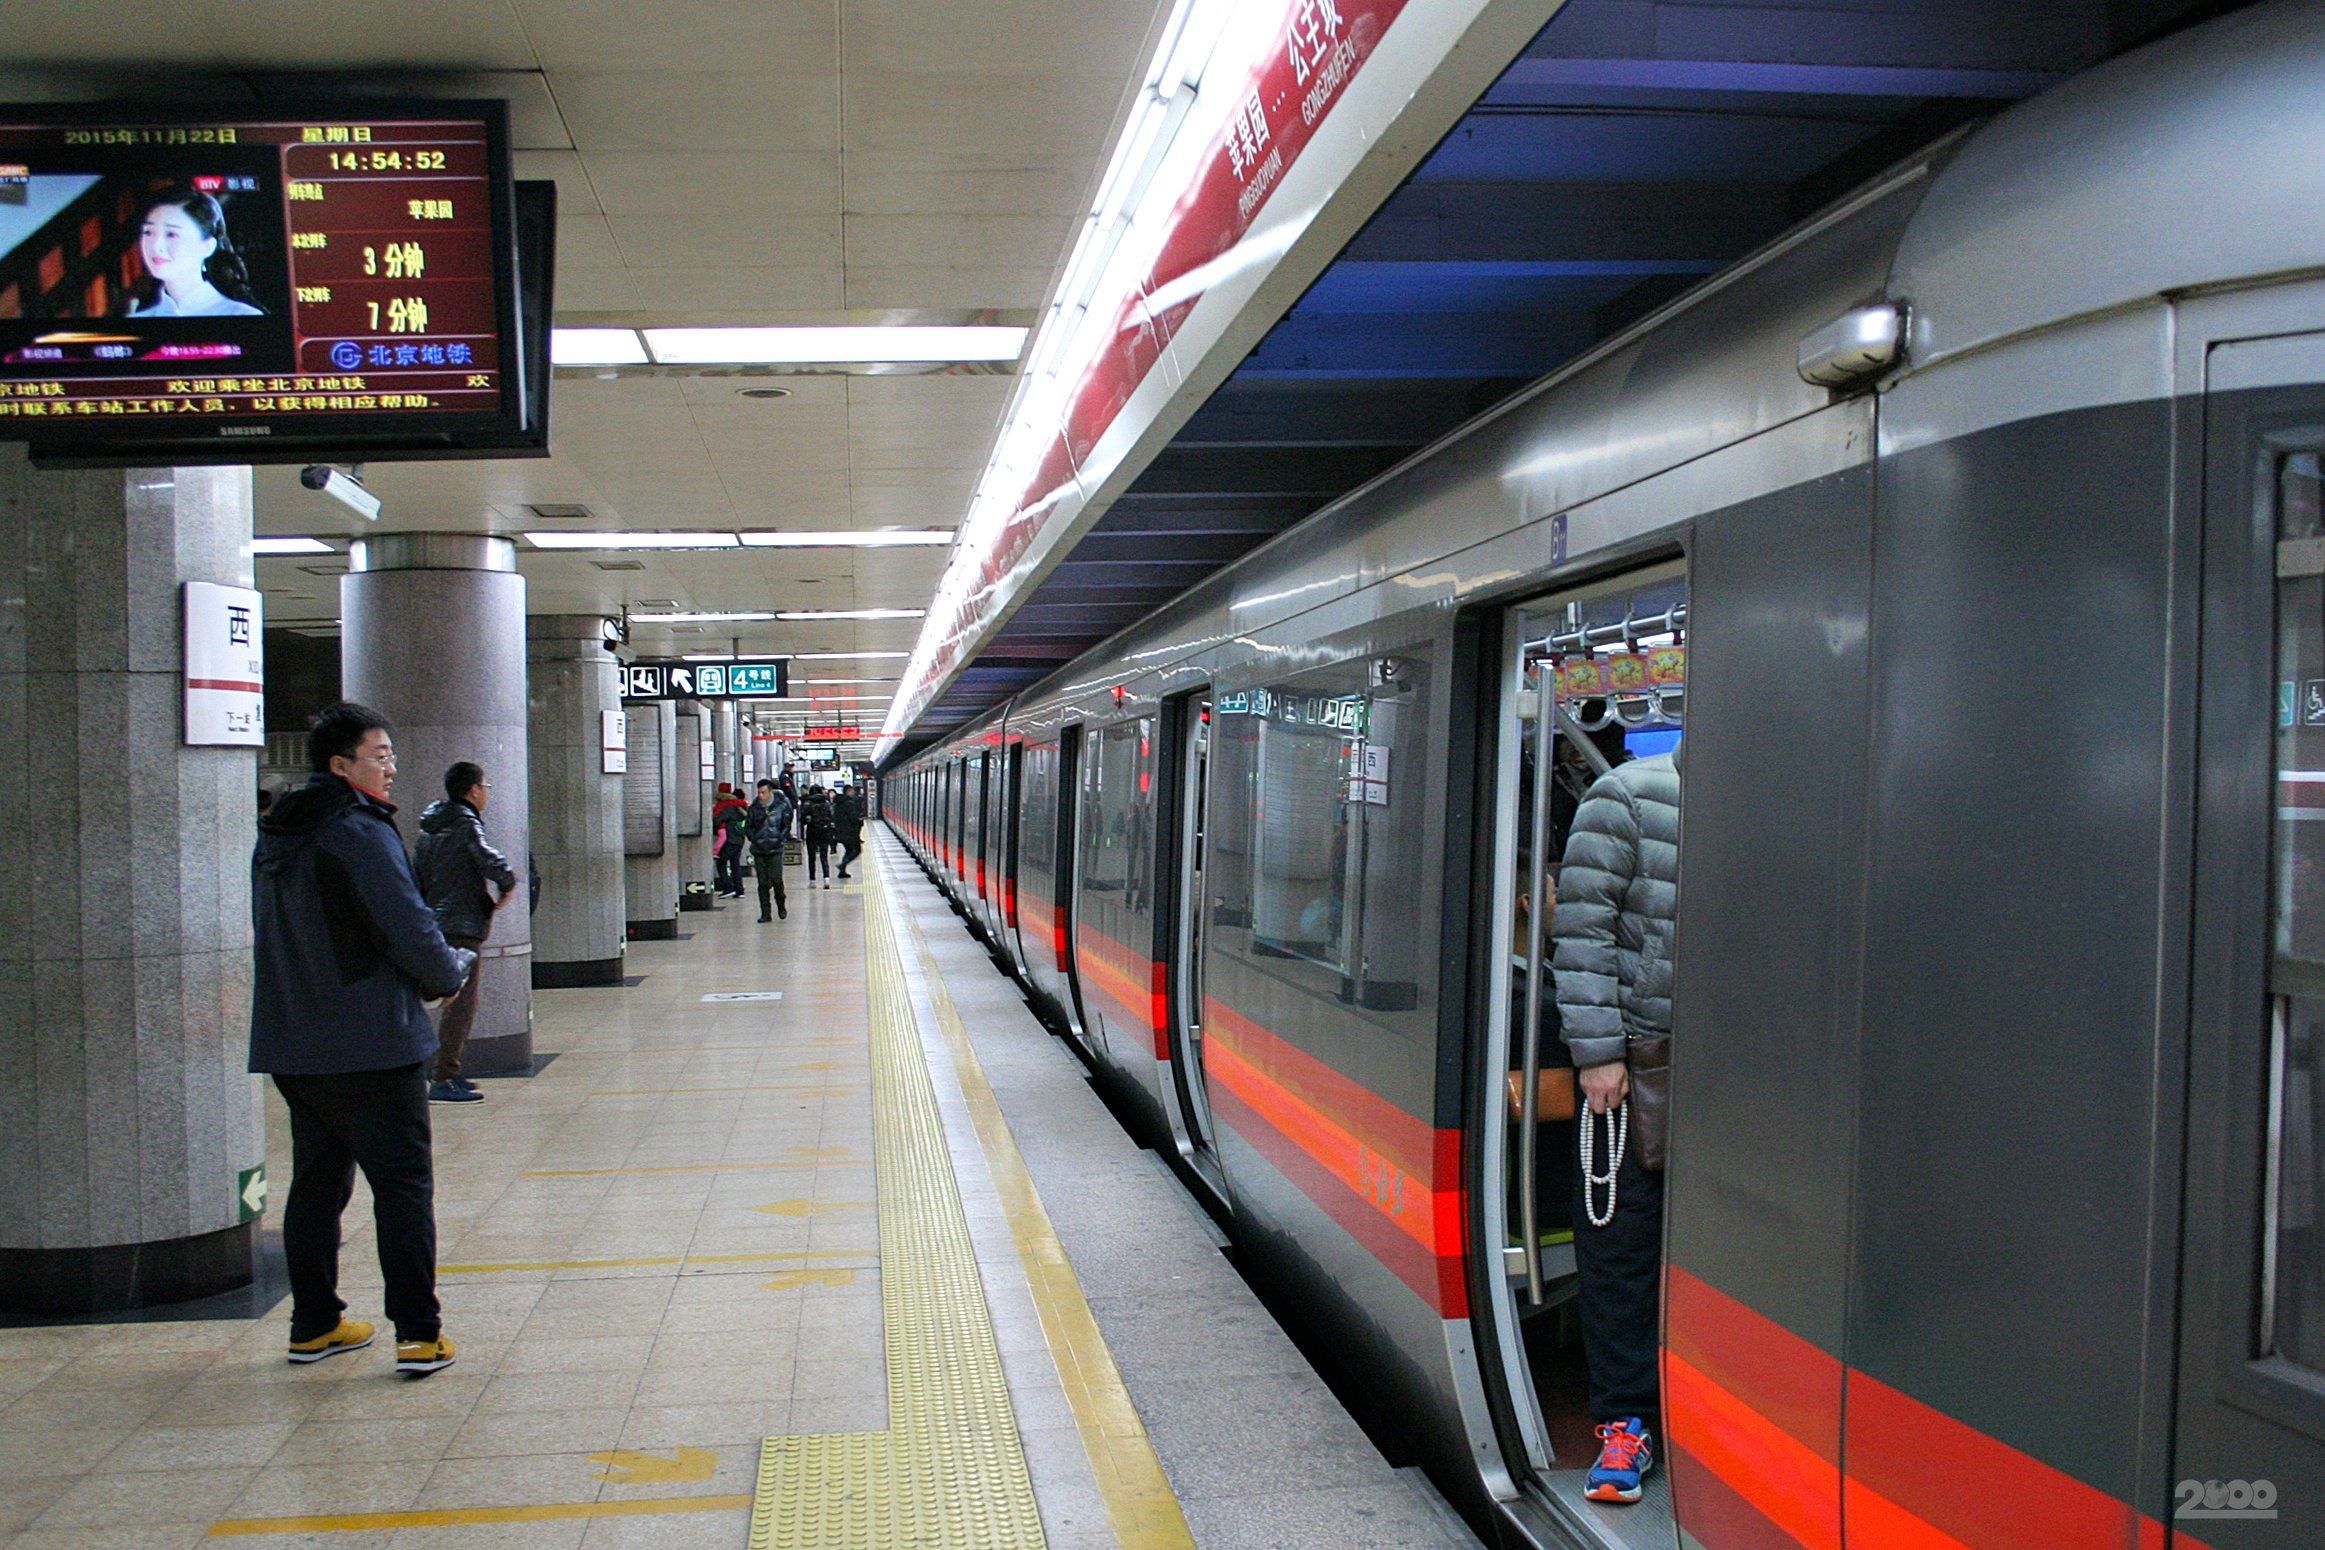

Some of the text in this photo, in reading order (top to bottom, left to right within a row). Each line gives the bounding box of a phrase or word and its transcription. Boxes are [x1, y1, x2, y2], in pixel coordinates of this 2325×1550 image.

[65, 126, 371, 145] 2015年11月22日 星期日
[329, 151, 446, 171] 14:54:52
[407, 199, 453, 219] 苹果园
[384, 242, 424, 278] 分钟
[296, 286, 331, 302] 下次列车
[387, 297, 428, 333] 分钟
[368, 343, 473, 366] 北京地铁
[167, 377, 366, 394] 欢迎乘坐北京地铁
[220, 426, 271, 437] SAMSUNG
[227, 605, 250, 648] 西
